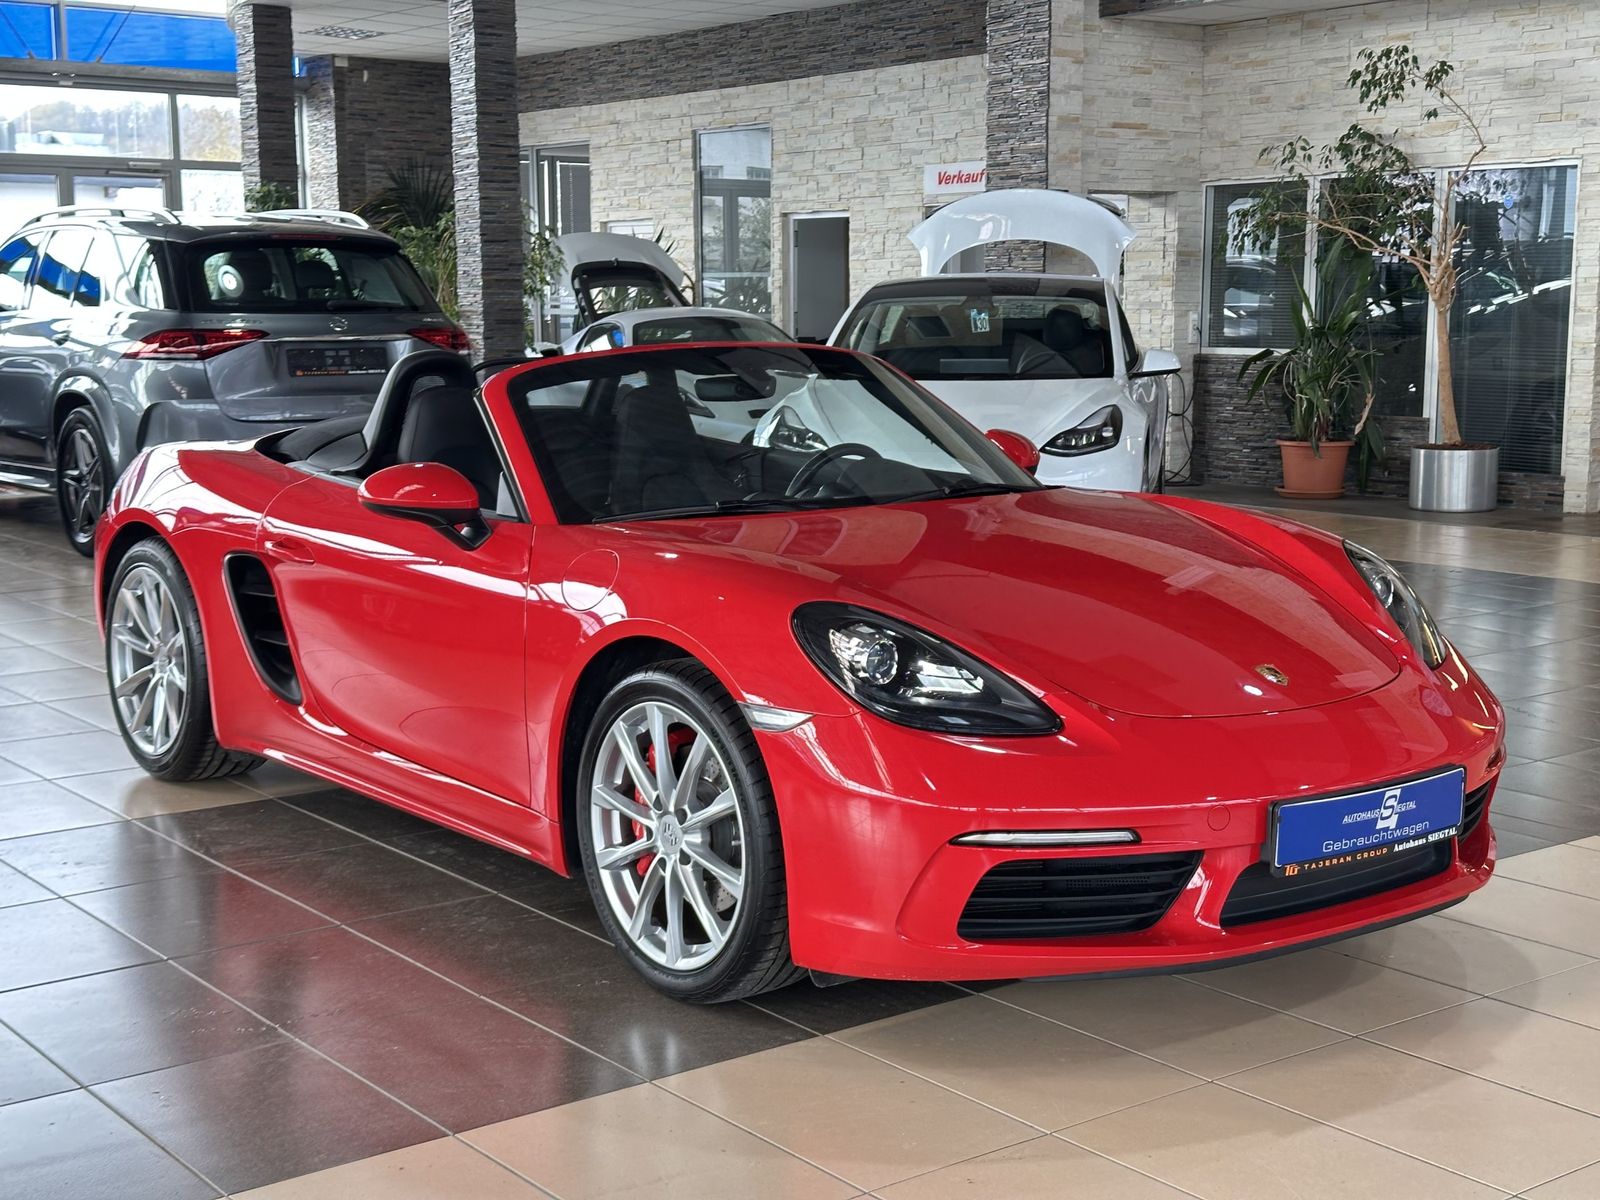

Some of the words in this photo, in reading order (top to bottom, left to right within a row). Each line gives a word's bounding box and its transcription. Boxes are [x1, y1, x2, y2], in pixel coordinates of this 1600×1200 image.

[937, 169, 985, 185] Verkauf
[1342, 808, 1380, 824] AUTOHAUS
[1322, 820, 1429, 853] Gebrauchtwagen
[1304, 855, 1352, 870] TAJERAN
[1356, 847, 1388, 860] GROUP
[1393, 837, 1427, 852] Autohaus
[1428, 828, 1457, 843] SIEGTAL
